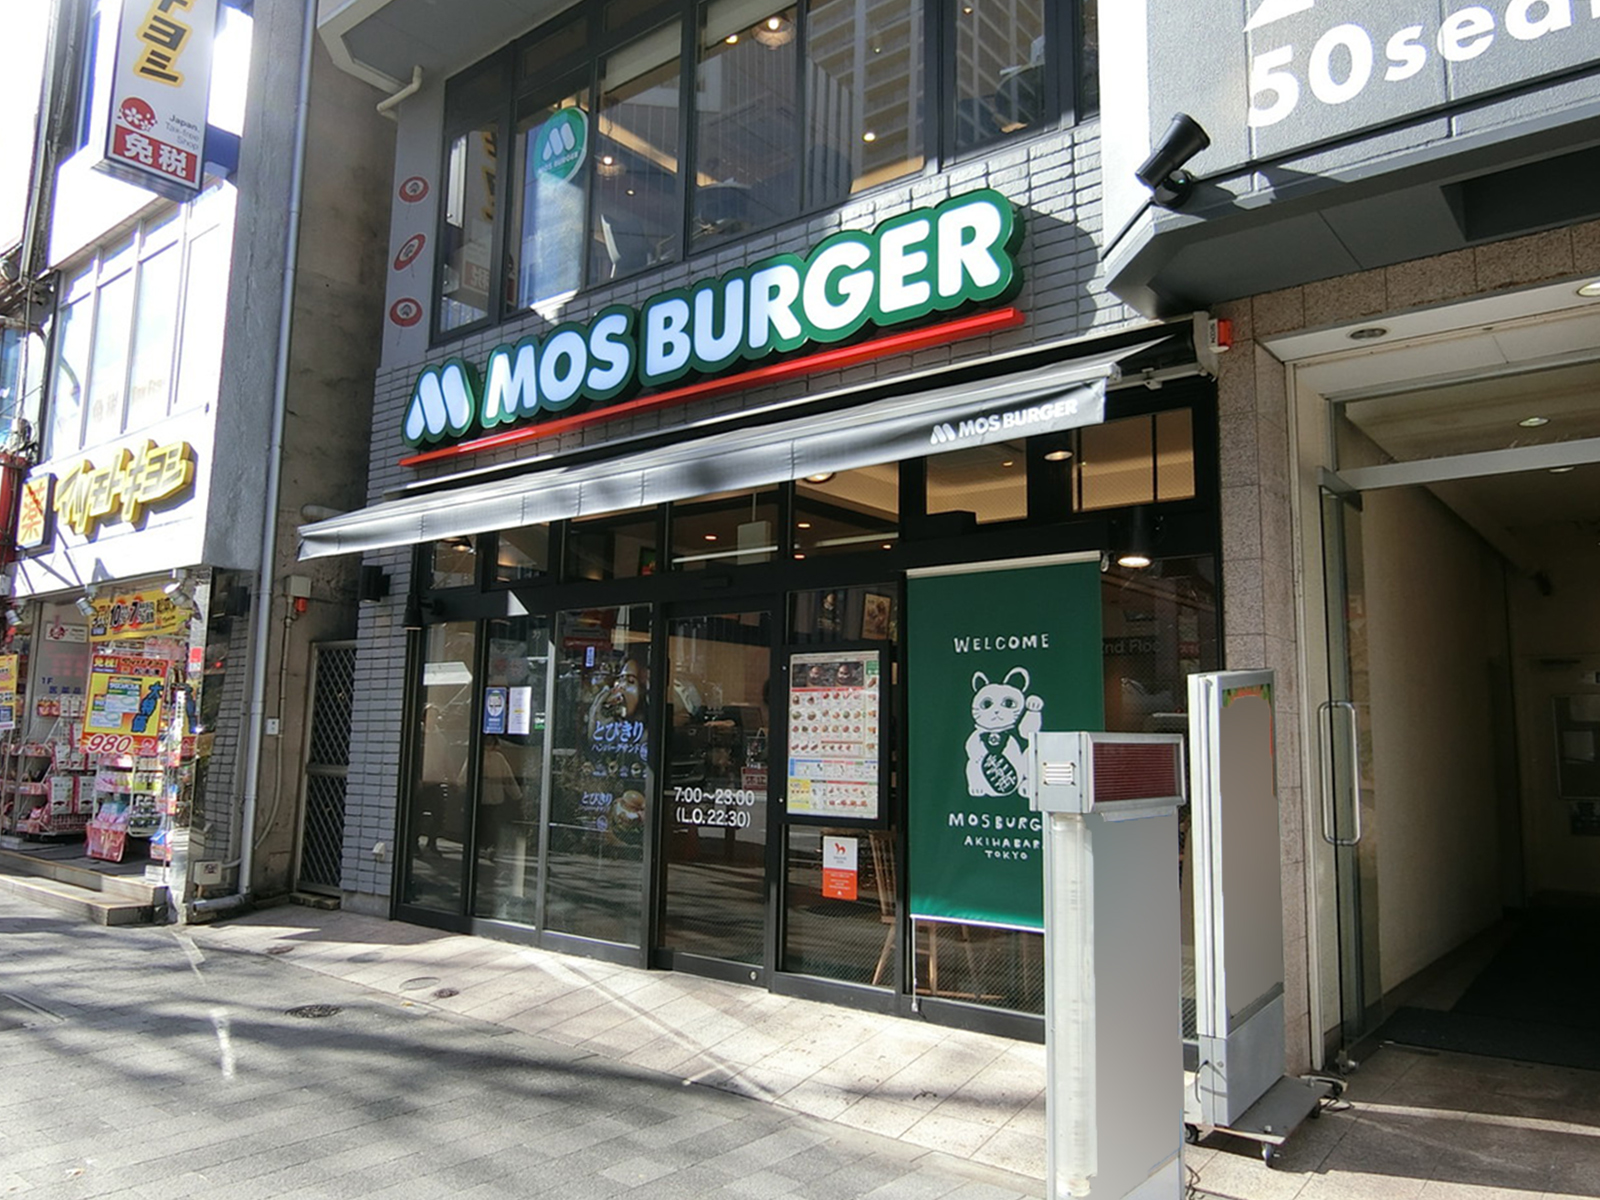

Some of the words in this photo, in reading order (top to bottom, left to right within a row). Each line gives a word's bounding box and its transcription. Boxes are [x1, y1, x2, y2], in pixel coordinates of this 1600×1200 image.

[1248, 0, 1600, 129] 50sea
[123, 132, 187, 177] 免税
[482, 312, 631, 424] MOS
[643, 200, 1003, 378] BURGER
[957, 413, 1001, 438] MOS
[1002, 398, 1079, 430] BURGER
[953, 633, 1050, 653] WELCOME
[592, 720, 644, 743] とびきり
[87, 734, 132, 753] 980
[964, 835, 1043, 850] AKIHABAR
[984, 850, 1028, 860] TOKYO
